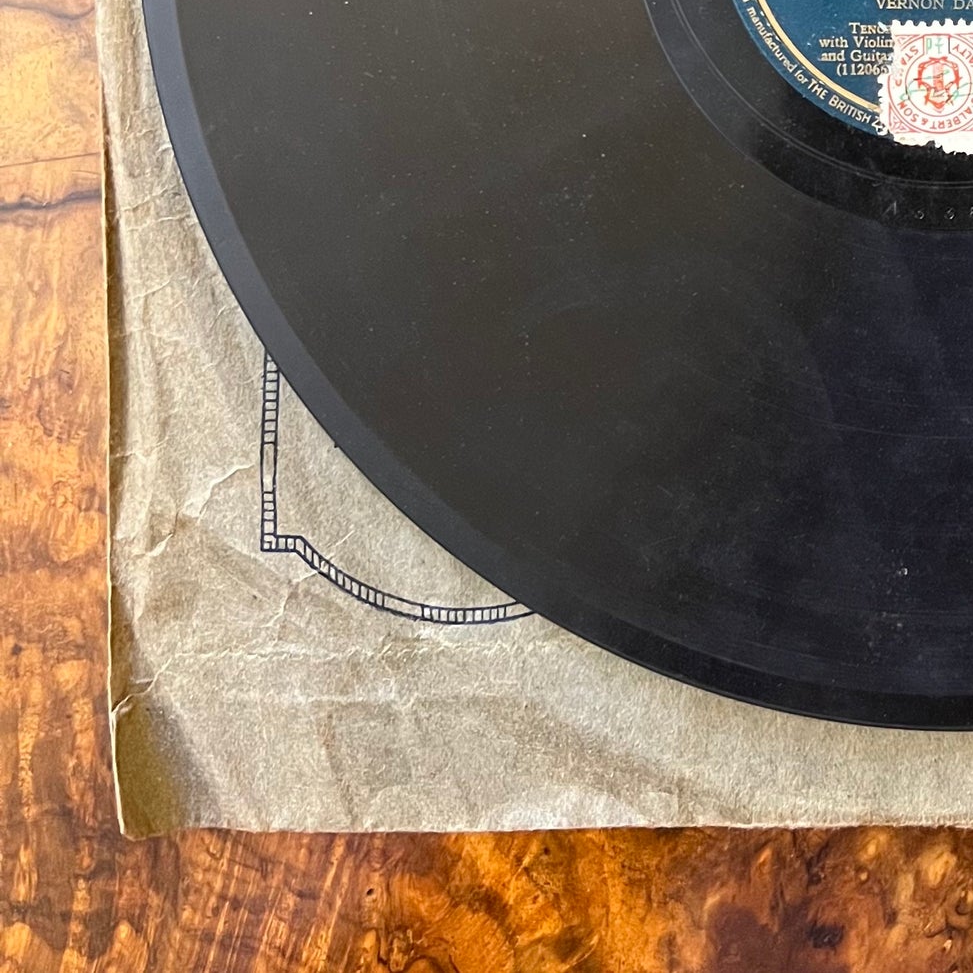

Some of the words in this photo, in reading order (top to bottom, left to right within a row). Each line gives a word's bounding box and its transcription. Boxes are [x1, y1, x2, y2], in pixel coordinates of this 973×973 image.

[819, 36, 849, 49] with
[821, 50, 846, 62] and
[747, 6, 800, 73] manufactured
[794, 69, 810, 85] for
[807, 80, 829, 100] THE
[828, 95, 872, 124] BRITISH
[897, 101, 920, 123] SON
